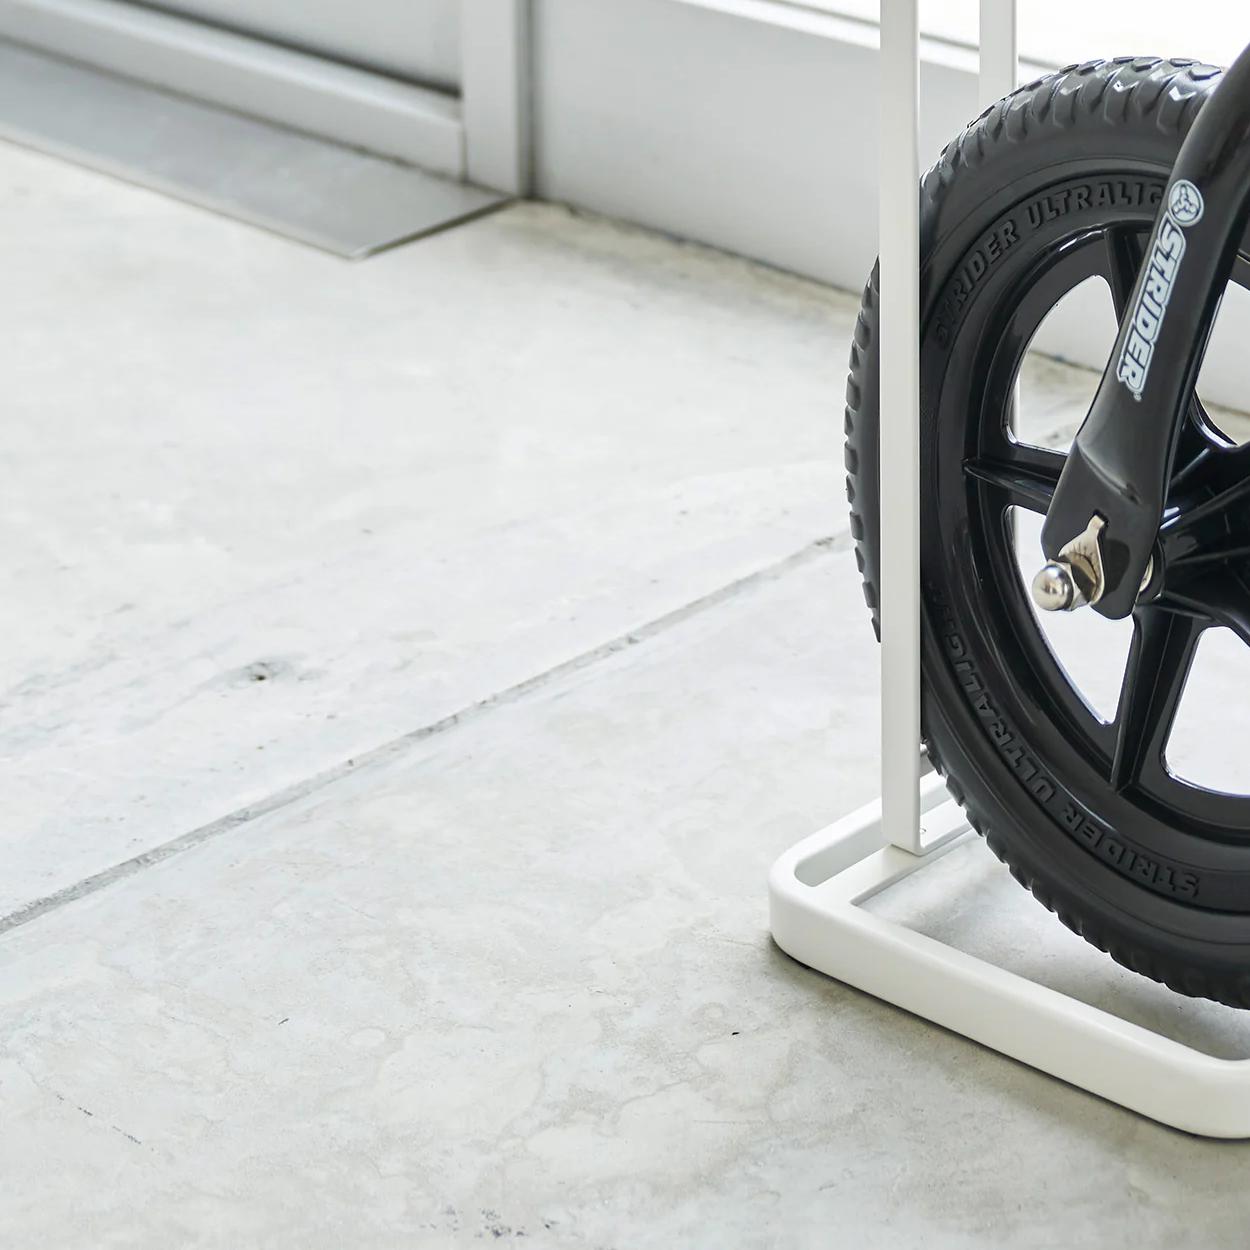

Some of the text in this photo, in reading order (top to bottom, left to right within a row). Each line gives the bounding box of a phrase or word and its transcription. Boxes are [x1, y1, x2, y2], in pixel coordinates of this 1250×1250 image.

[930, 219, 1022, 347] STRIDER
[1117, 213, 1186, 393] STRIDER
[1059, 802, 1201, 899] STRIDER
